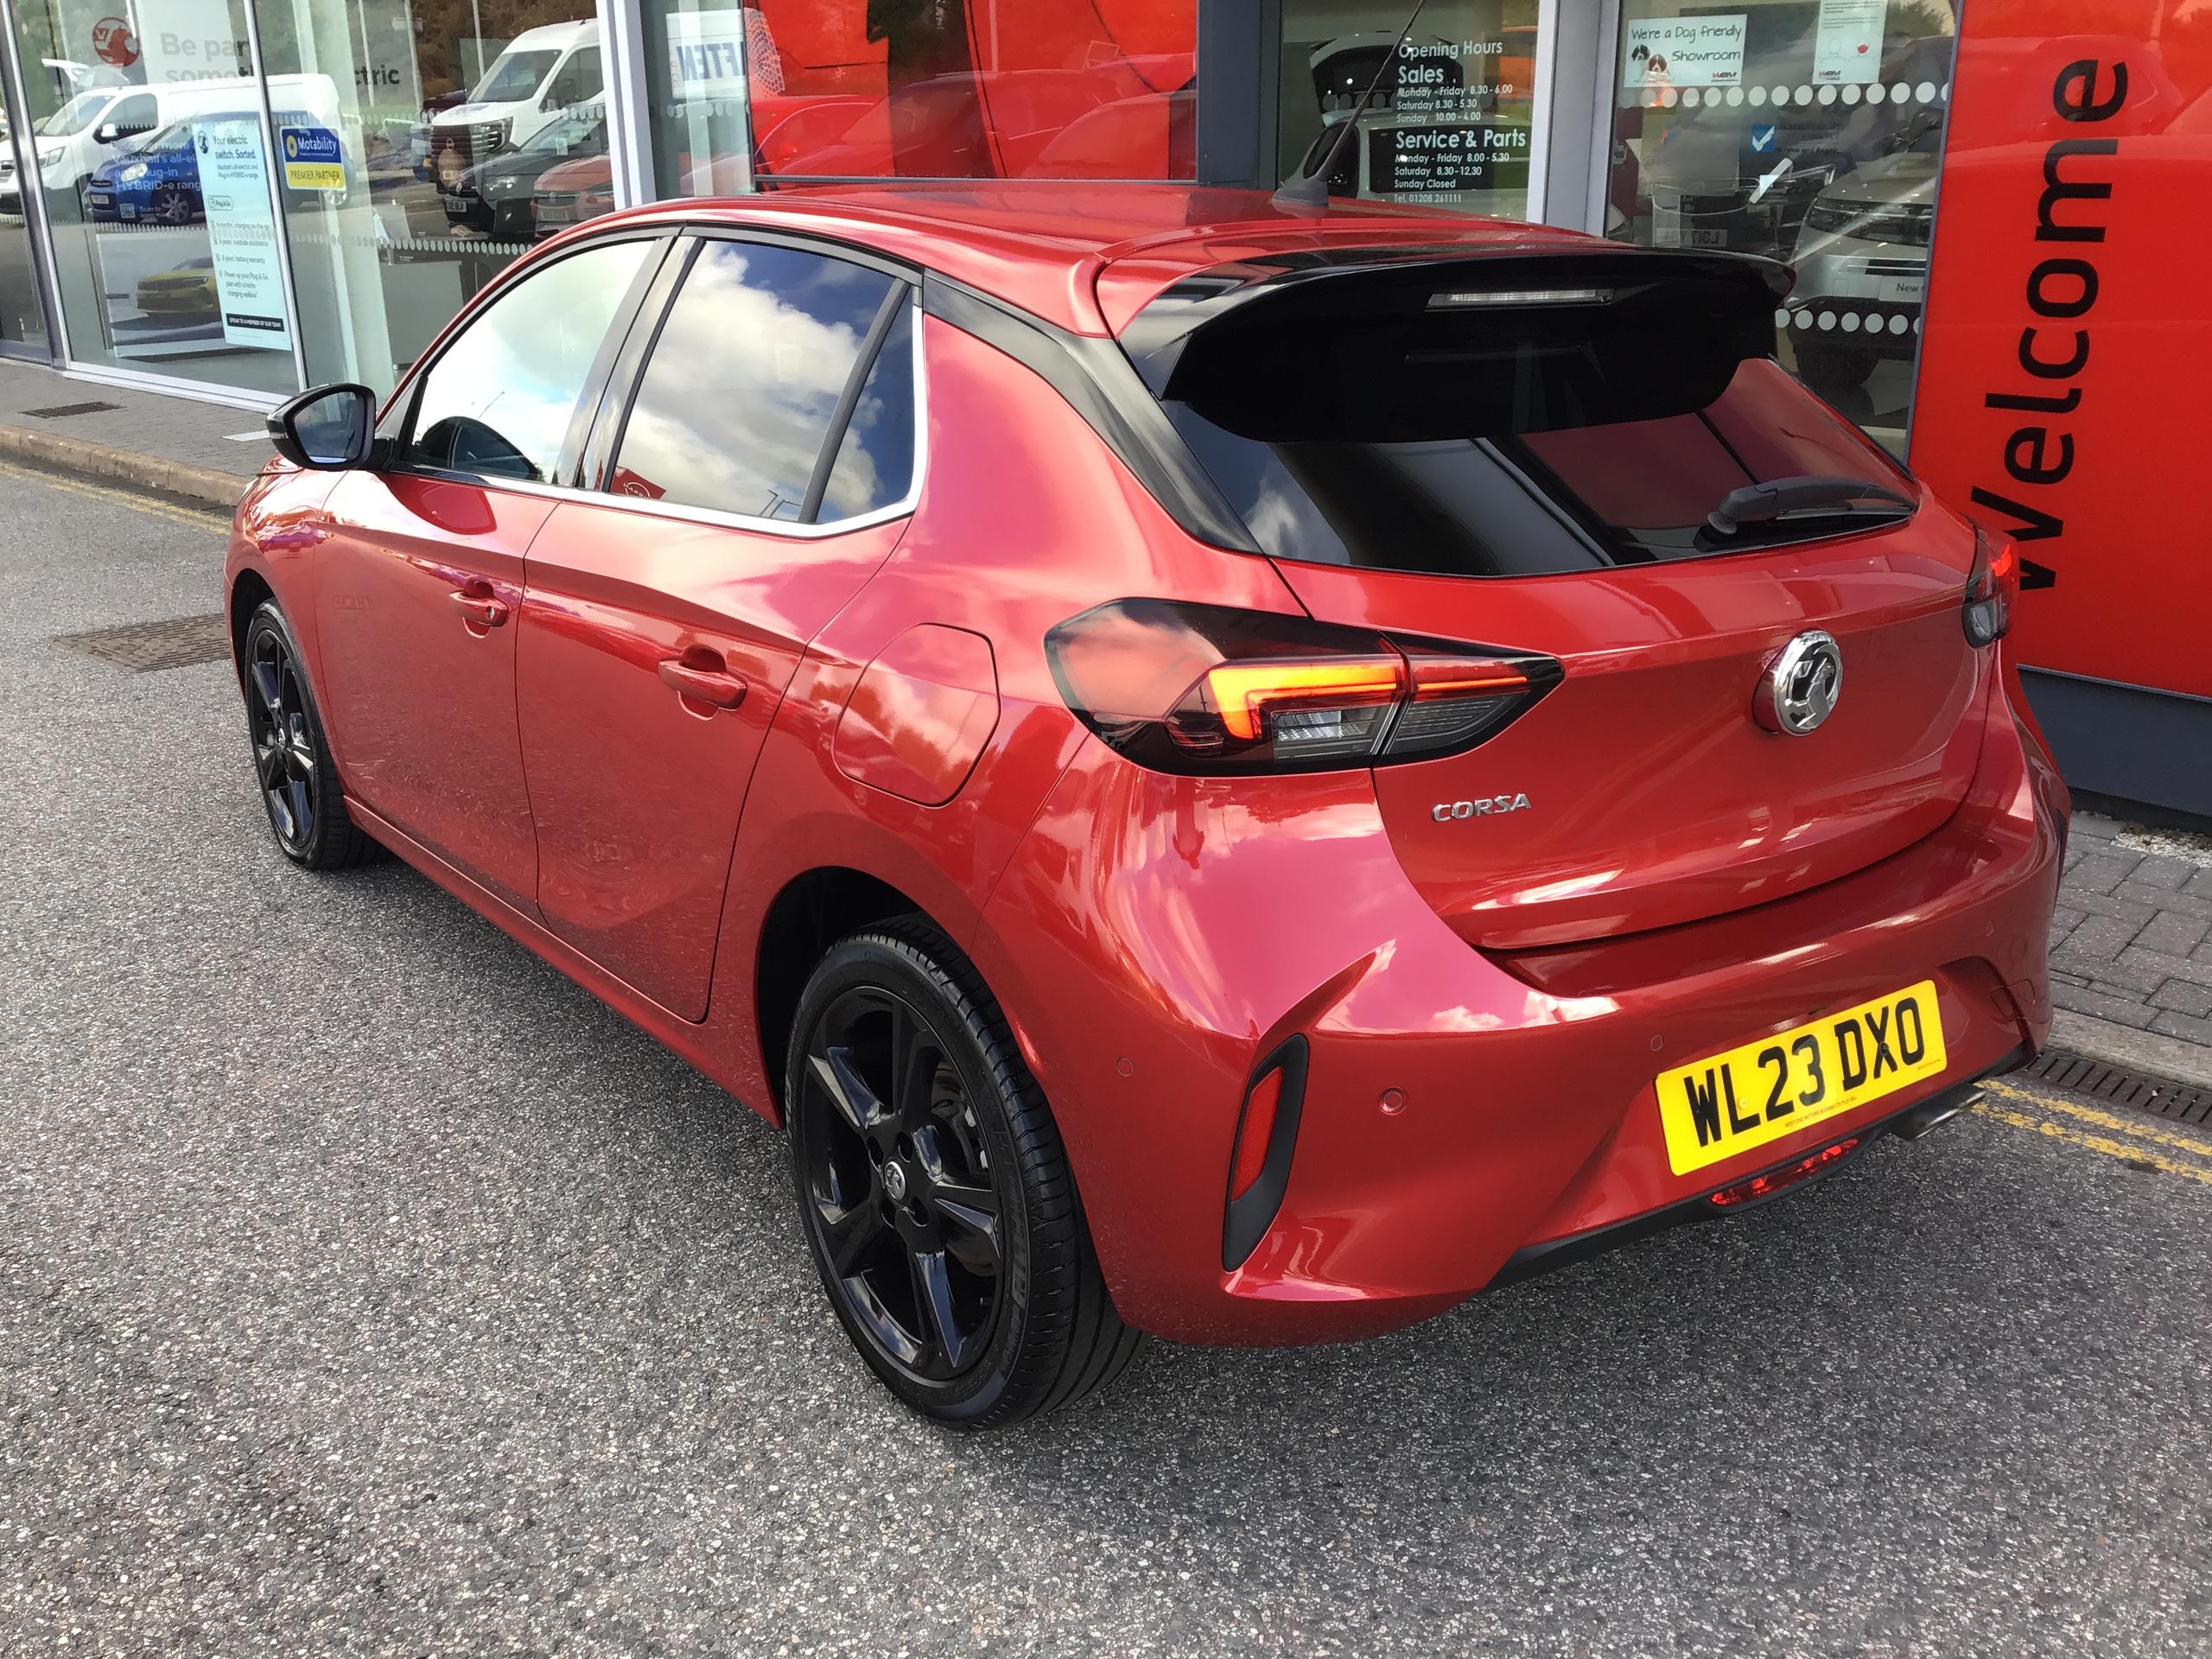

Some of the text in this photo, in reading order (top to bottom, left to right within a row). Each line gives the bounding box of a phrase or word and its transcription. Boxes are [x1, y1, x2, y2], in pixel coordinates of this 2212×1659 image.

[1631, 24, 1743, 44] We're a Dog friendly
[160, 32, 250, 62] Be par
[1399, 41, 1503, 61] Opening Hours
[1671, 50, 1740, 61] Showroom
[1398, 65, 1444, 84] Sales
[1396, 87, 1432, 98] Monday
[1440, 86, 1465, 97] Friday
[1471, 85, 1488, 94] 8.30
[1495, 84, 1512, 94] 6.00
[1396, 100, 1433, 111] Saturday
[1435, 99, 1452, 109] 8.30
[1396, 114, 1427, 124] Sunday
[1436, 112, 1456, 122] 10.00
[1464, 111, 1481, 121] 4.00
[213, 135, 248, 145] Your electric
[297, 136, 337, 154] Motability
[1395, 129, 1526, 149] Service & Parts
[170, 154, 195, 163] all-el
[234, 149, 256, 158] Sorted.
[1395, 154, 1429, 164] Mnday
[1437, 154, 1463, 164] Friday
[1466, 153, 1484, 162] 8.00
[1491, 152, 1510, 162] 5.30
[144, 168, 179, 178] lug-in
[290, 169, 340, 181] PREMIER PARTNER
[1395, 167, 1431, 177] Saturday
[1436, 166, 1454, 175] 8.30
[1460, 166, 1482, 175] 12.30
[116, 181, 201, 191] HYBRID-e rang
[1394, 179, 1456, 190] Sunday Closed
[1394, 194, 1462, 203] Tel. 01208 261111
[1896, 283, 1919, 292] New
[1971, 59, 2128, 591] Welcome
[1433, 793, 1531, 822] CORSA
[1684, 997, 1925, 1147] WL23 DXO
